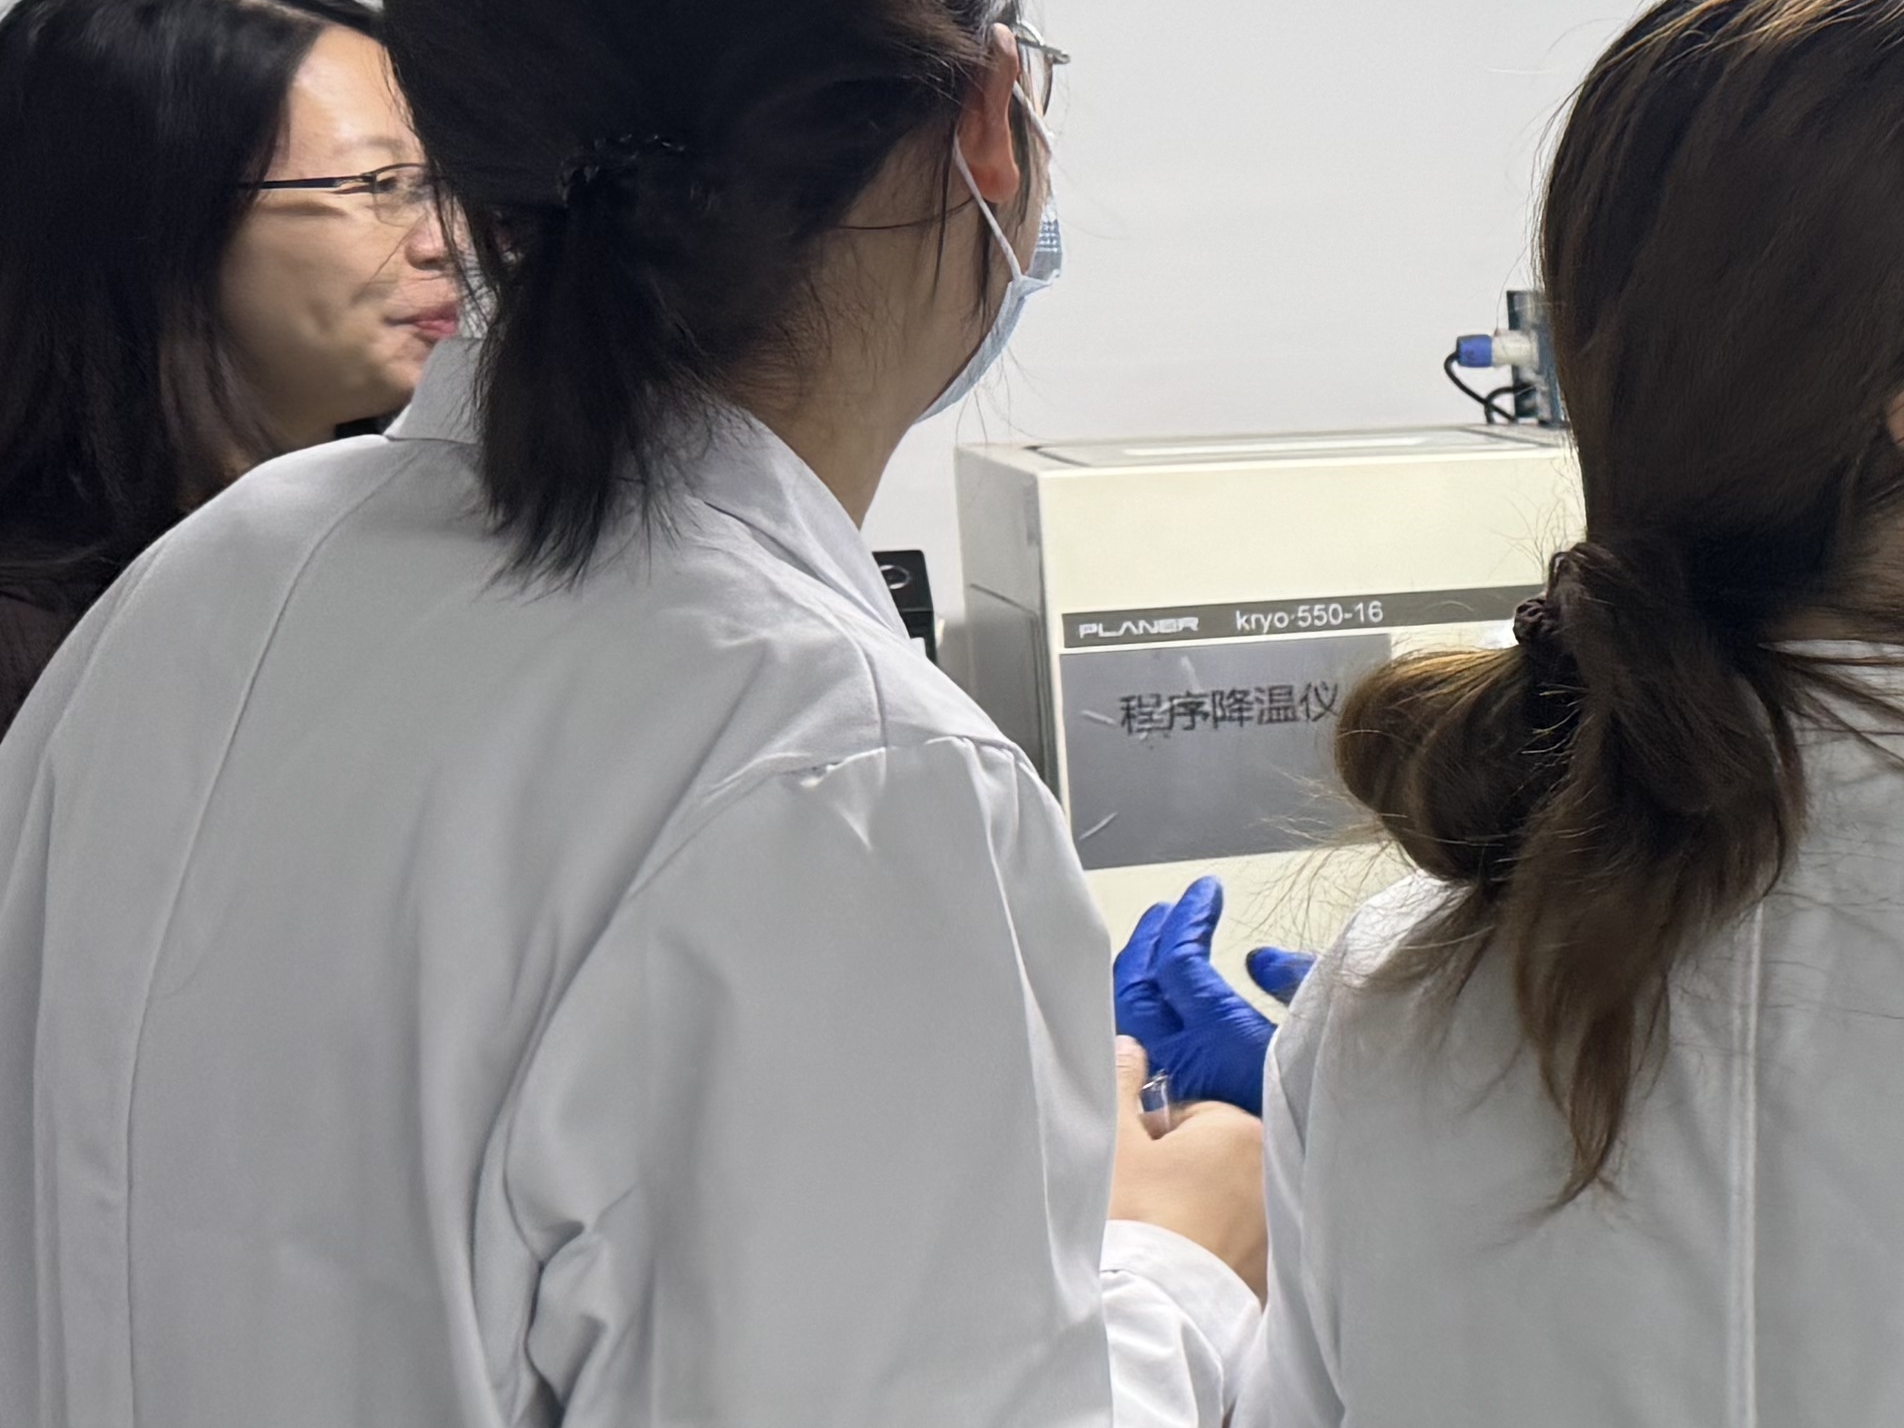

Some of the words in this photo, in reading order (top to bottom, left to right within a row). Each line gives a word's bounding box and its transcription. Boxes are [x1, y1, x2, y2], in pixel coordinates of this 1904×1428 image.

[1079, 617, 1199, 639] PLANER
[1236, 610, 1288, 634] kryo
[1296, 600, 1384, 627] 550-16
[1120, 681, 1338, 734] 程序降温仪
